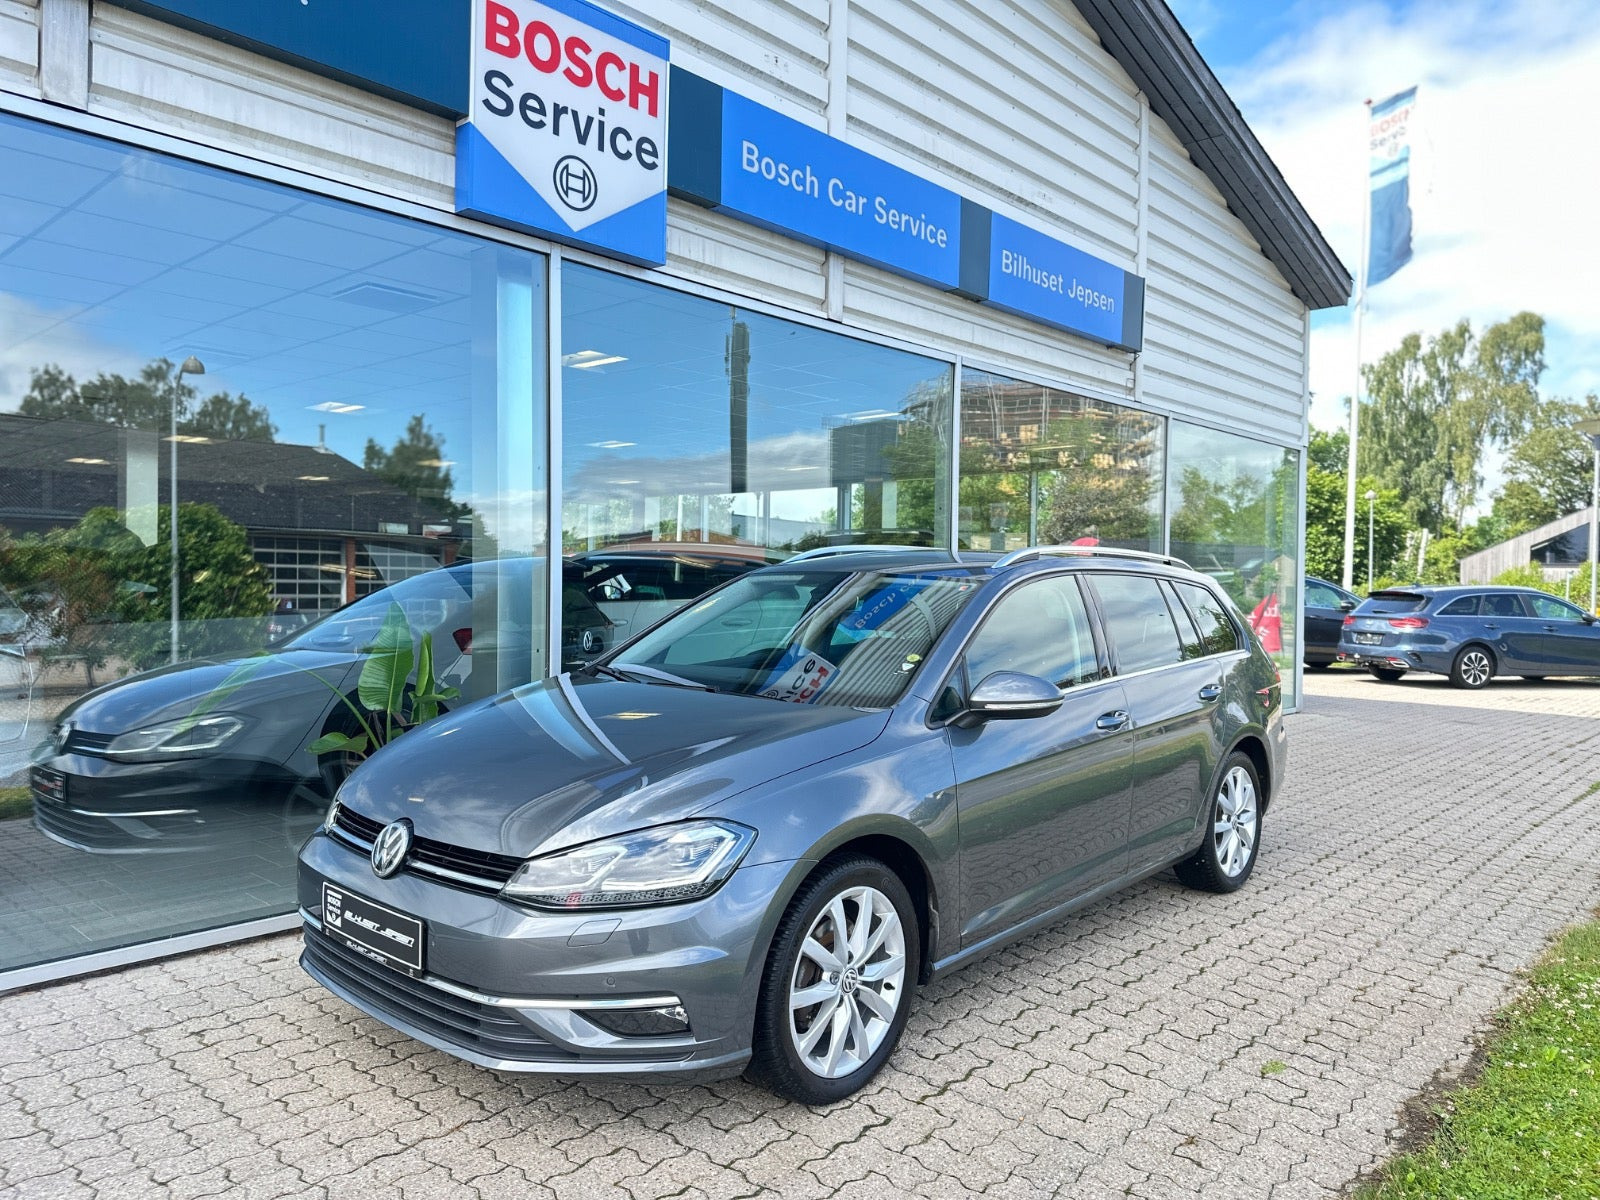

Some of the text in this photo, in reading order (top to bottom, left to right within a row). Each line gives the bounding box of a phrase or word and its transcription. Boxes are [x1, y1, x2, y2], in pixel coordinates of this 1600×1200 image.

[485, 0, 659, 118] BOSCH
[482, 69, 659, 171] Service
[741, 139, 948, 249] Bosch Car Service
[1001, 249, 1115, 315] Bilhuset Jepsen
